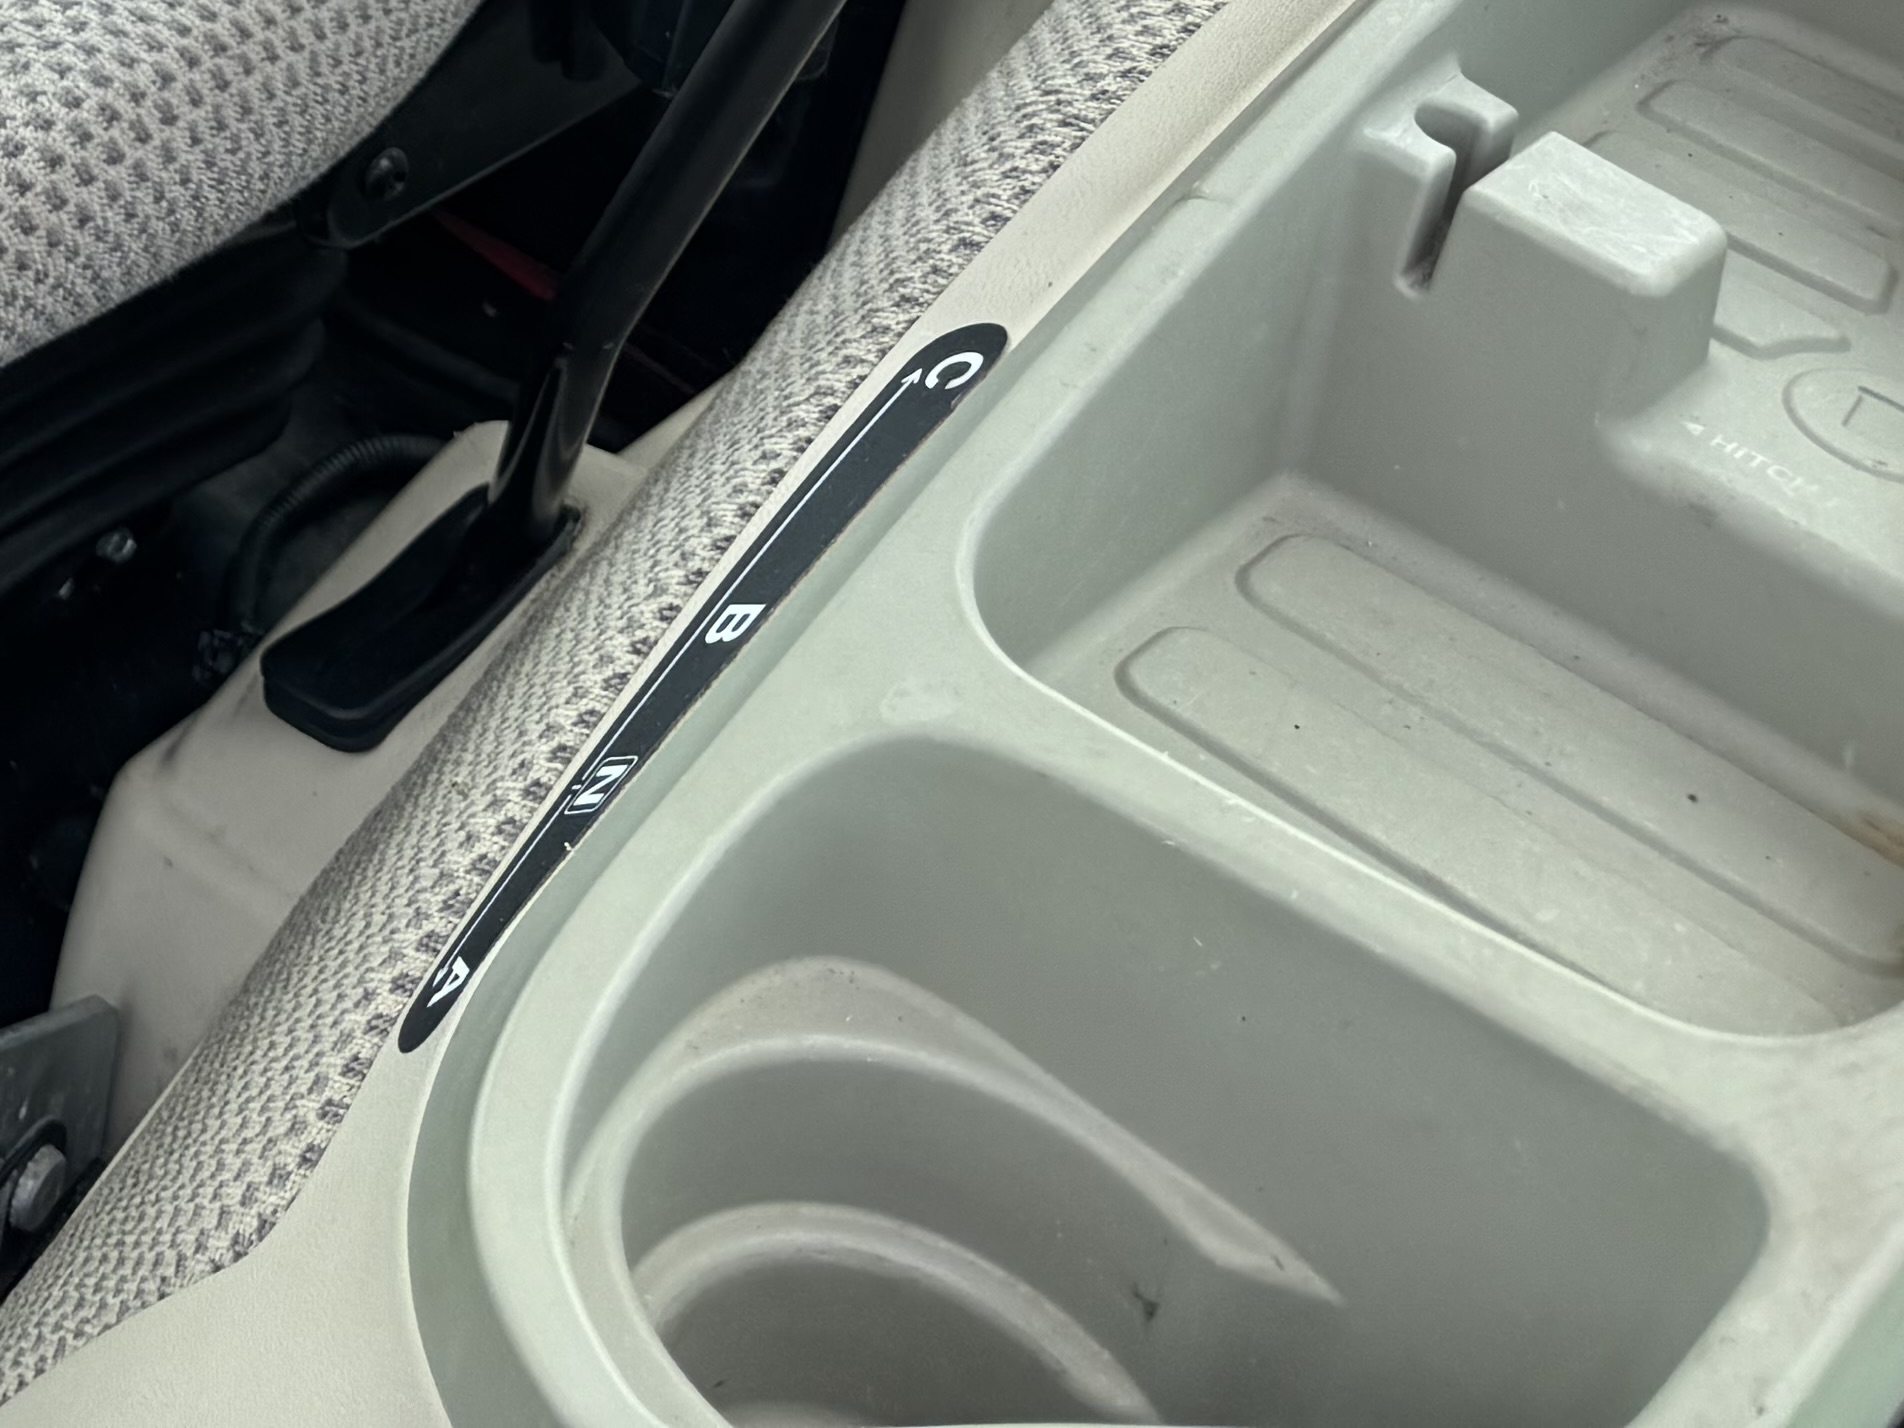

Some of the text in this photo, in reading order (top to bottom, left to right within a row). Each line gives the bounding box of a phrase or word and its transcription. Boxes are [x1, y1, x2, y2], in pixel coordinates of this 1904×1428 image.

[925, 351, 984, 390] C
[705, 604, 767, 644] B
[573, 764, 629, 806] N
[426, 955, 470, 1008] A
